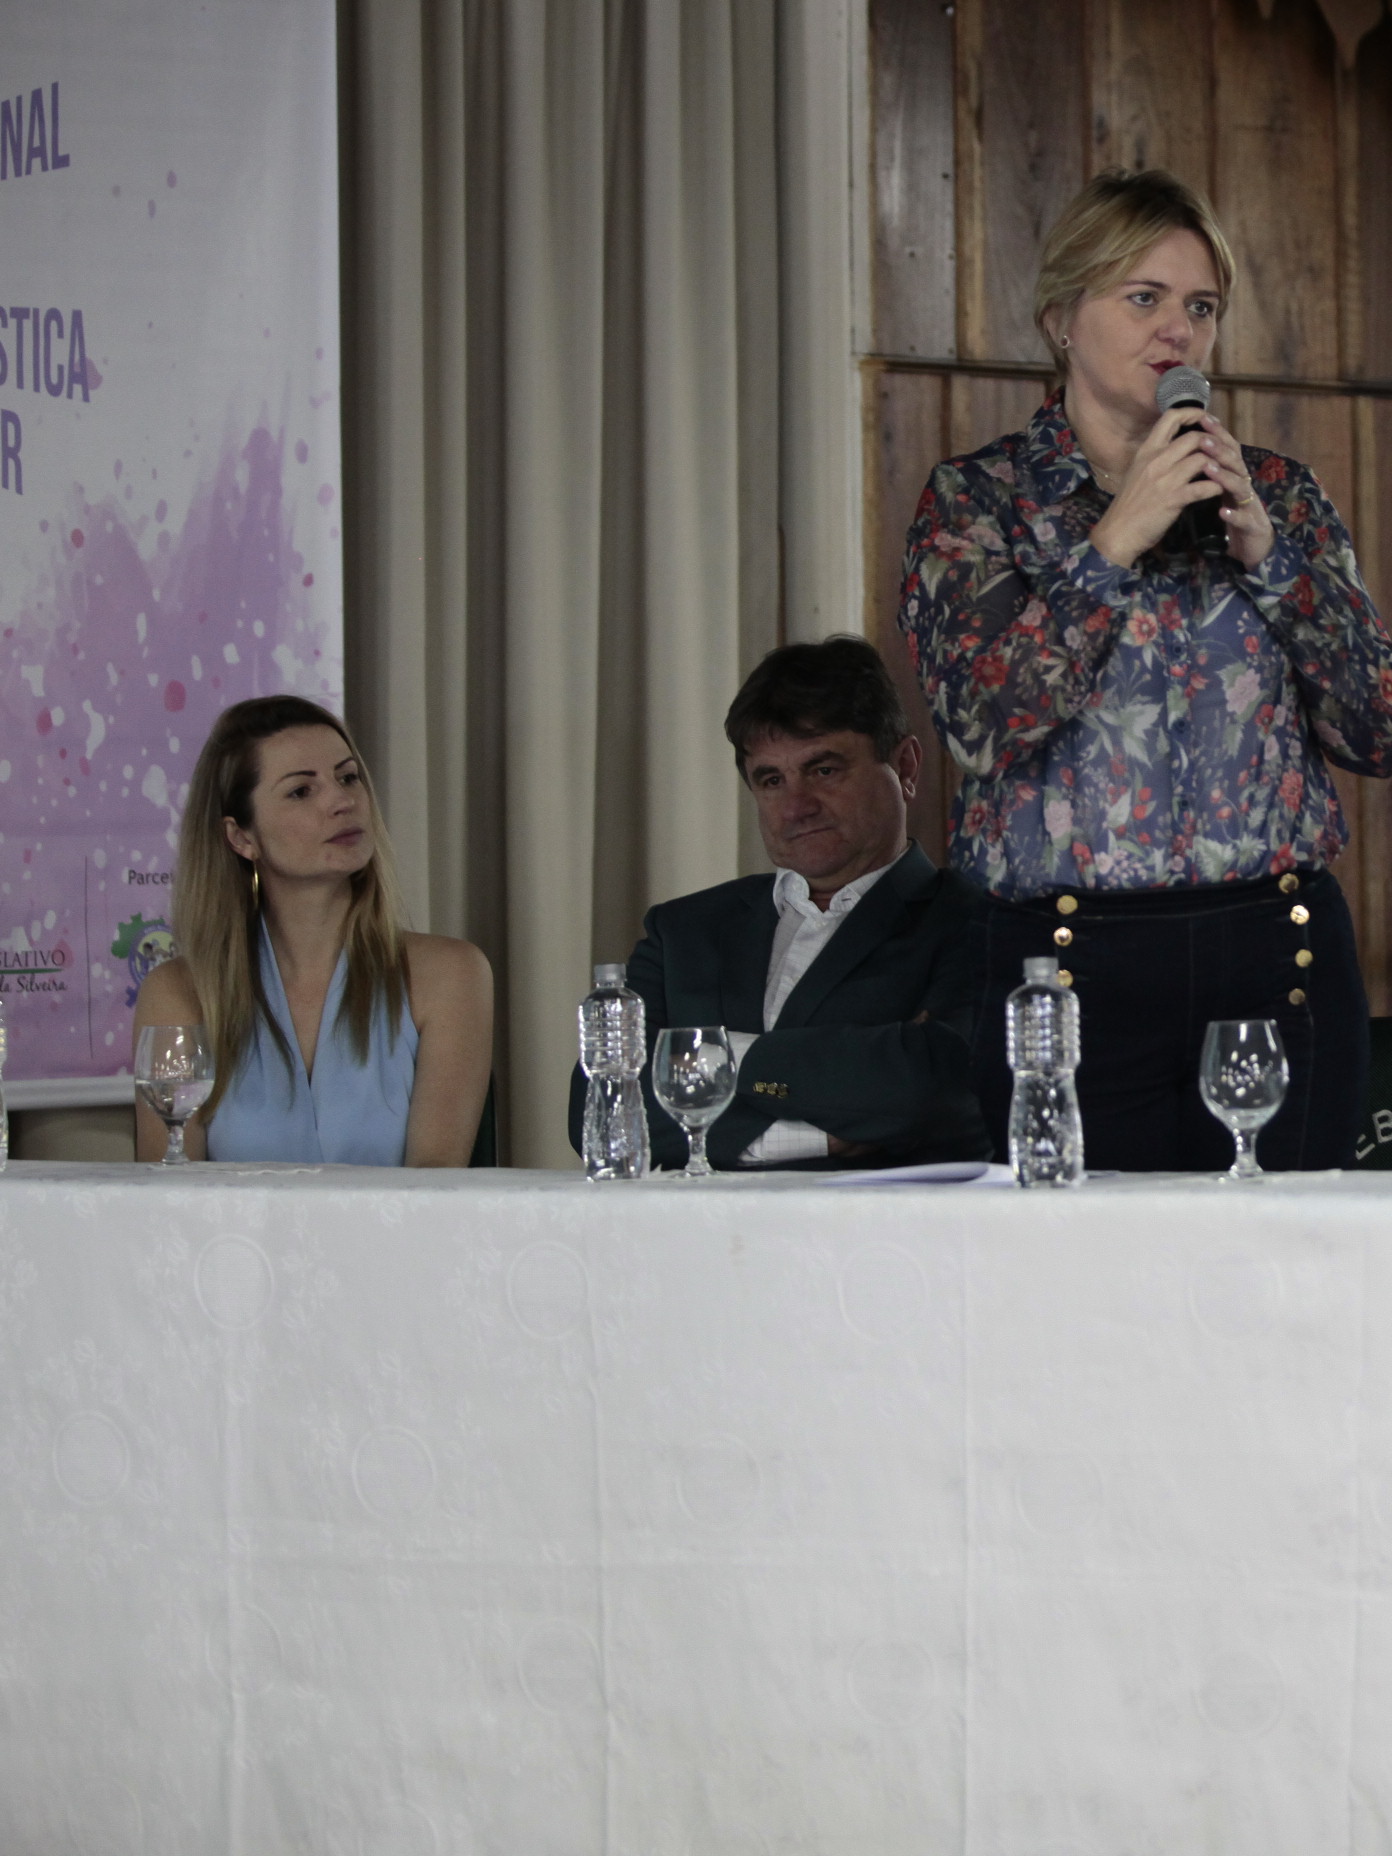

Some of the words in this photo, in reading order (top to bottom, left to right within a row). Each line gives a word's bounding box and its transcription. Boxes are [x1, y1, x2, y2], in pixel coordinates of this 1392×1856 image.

[0, 81, 70, 180] NAL
[1, 409, 23, 495] R
[0, 949, 65, 967] LATIVO
